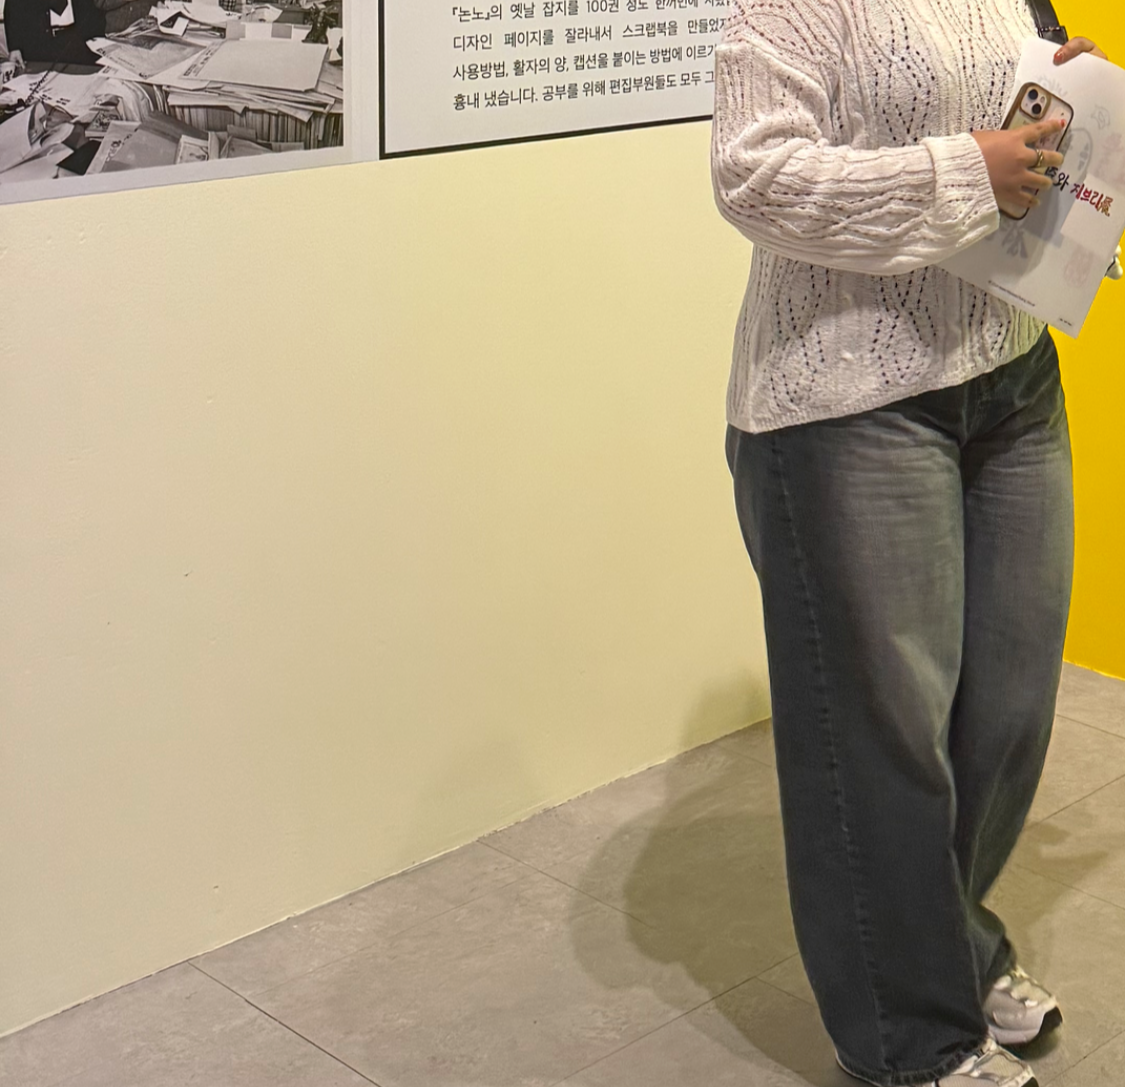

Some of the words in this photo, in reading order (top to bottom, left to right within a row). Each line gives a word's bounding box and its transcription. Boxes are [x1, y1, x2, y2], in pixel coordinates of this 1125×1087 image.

[509, 1, 535, 20] 옛날
[542, 0, 579, 17] 잡지를
[452, 60, 509, 81] 사용방법,
[512, 56, 550, 76] 활자의
[553, 55, 569, 73] 양,
[573, 52, 608, 71] 캡션을
[611, 49, 646, 68] 붙이는
[649, 46, 682, 64] 방법에
